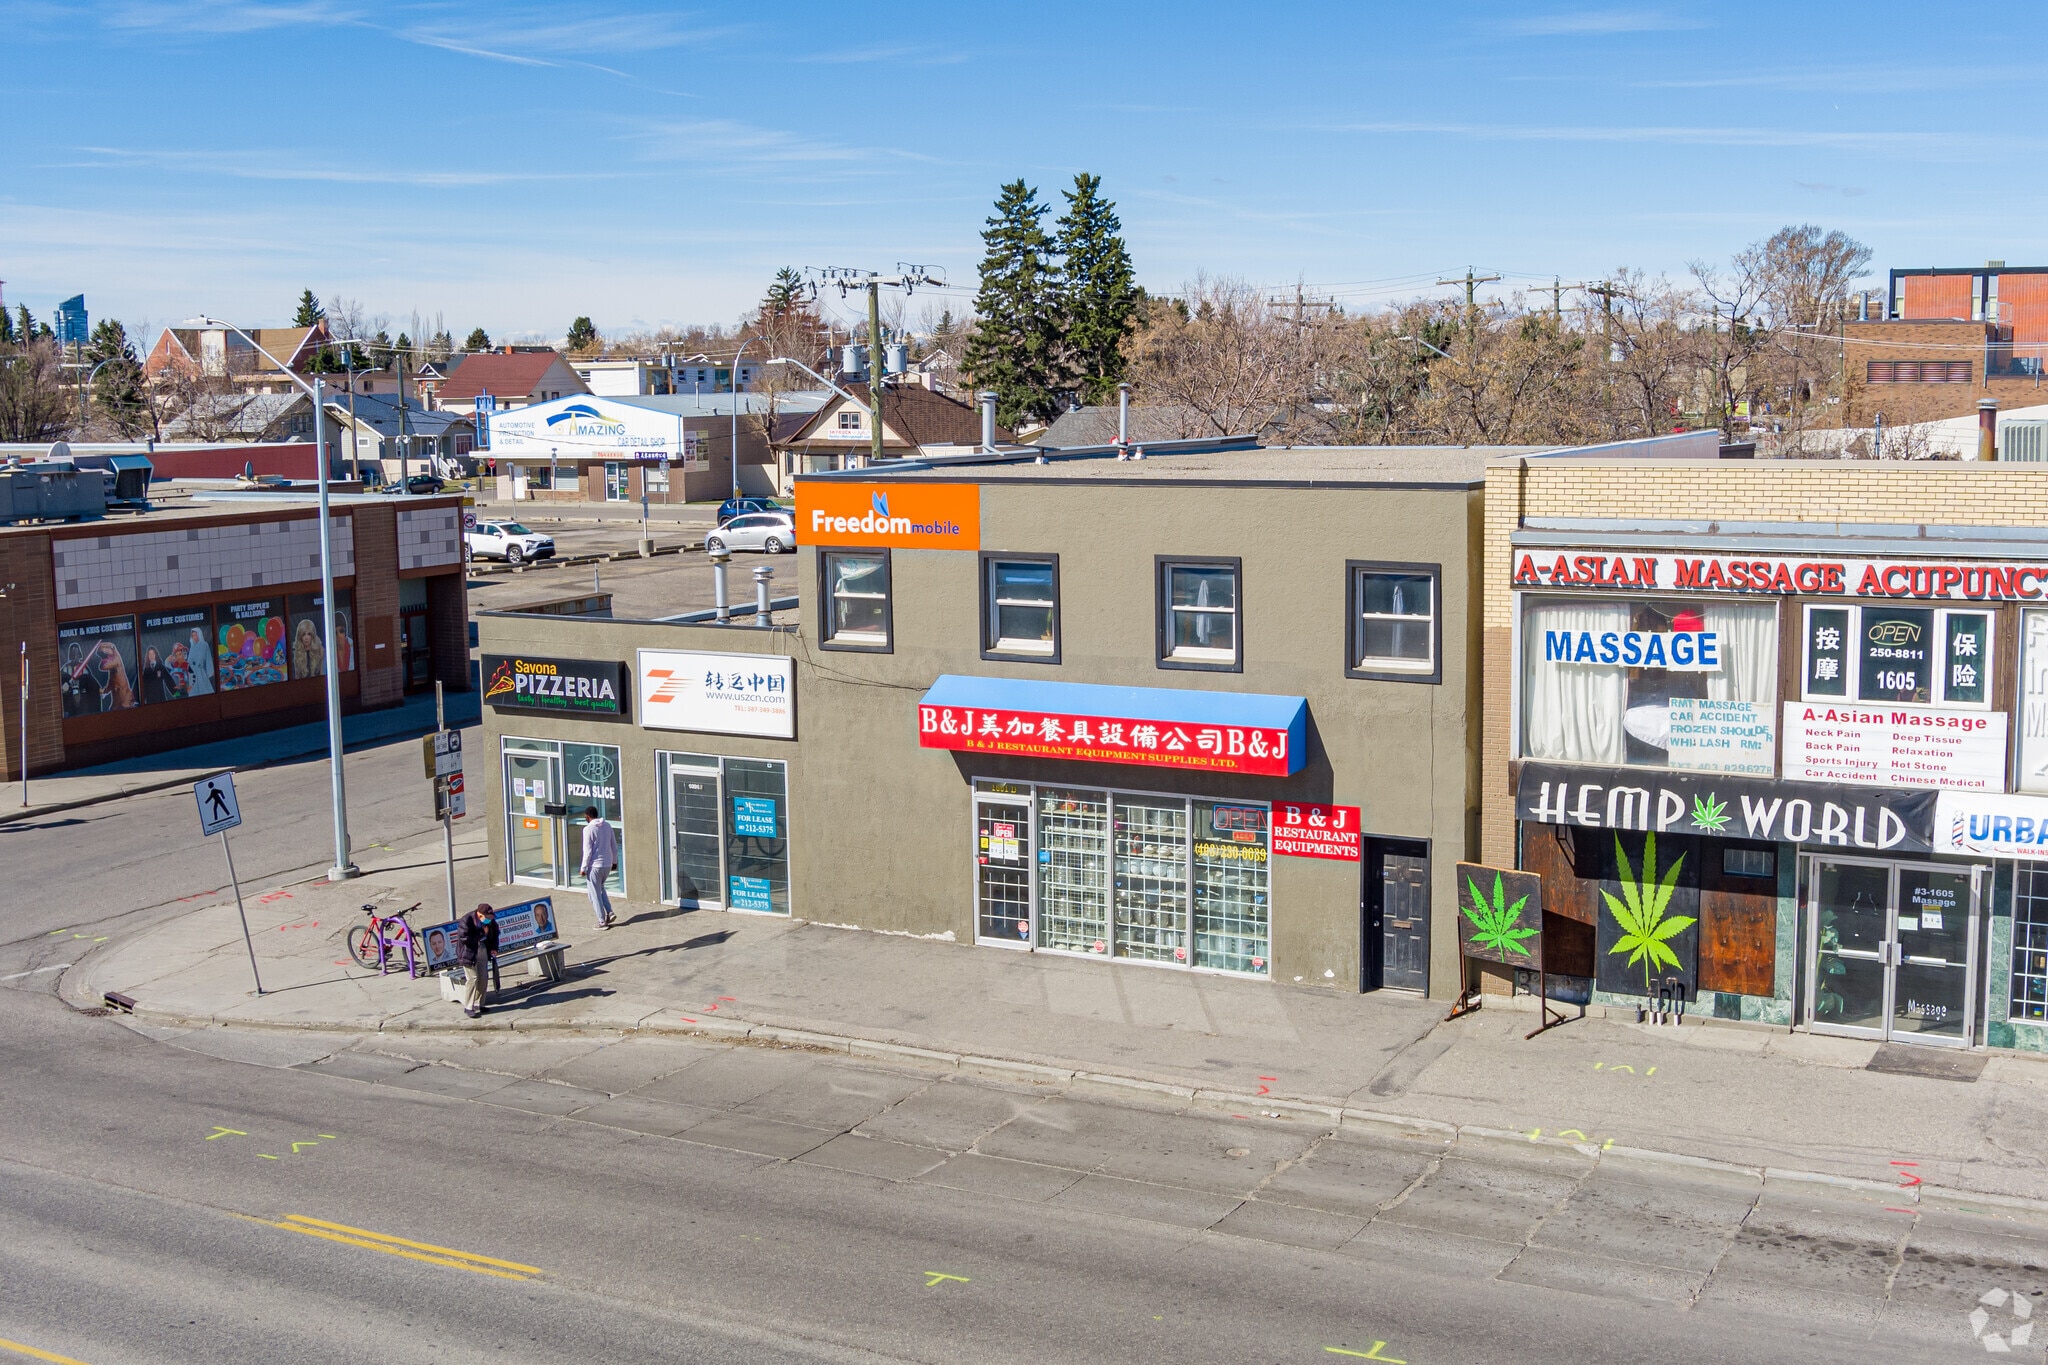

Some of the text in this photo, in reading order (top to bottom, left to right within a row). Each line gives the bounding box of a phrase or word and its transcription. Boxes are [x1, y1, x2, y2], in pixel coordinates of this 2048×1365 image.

[569, 413, 626, 435] AMAZING
[618, 437, 666, 447] CAR DETAIL SHOP
[812, 509, 960, 535] Freedom mobile
[1514, 554, 1658, 588] A-ASIAN
[1673, 558, 1846, 594] MASSAGE
[230, 602, 270, 613] PARTY SUPPLIES
[241, 609, 266, 618] BALLOONS
[146, 612, 204, 627] PLUS SIZE COSTUMES
[60, 629, 78, 638] ADULT
[86, 625, 100, 634] KIDS
[101, 621, 133, 632] COSTUMES
[1868, 624, 1922, 643] OPEN
[1545, 630, 1718, 666] MASSAGE
[1814, 626, 1841, 681] 按摩
[1869, 647, 1923, 660] 250-8811
[515, 659, 557, 675] Savona
[1952, 632, 1978, 687] 保险
[515, 674, 615, 699] PIZZERIA
[705, 670, 786, 694] 转运中国
[1877, 670, 1916, 691] 1605
[517, 694, 616, 711] tasty healthy best quality
[705, 691, 786, 704] www.uszcn.com
[1670, 698, 1752, 712] RMT MASSAGE
[734, 705, 747, 713] TEL:
[1670, 711, 1758, 723] CAR ACCIDENT
[1802, 708, 1987, 732] A-Asian Massage
[977, 713, 1223, 755] 美加餐具設備公司
[1670, 724, 1773, 742] FROZEN SHOULDER
[1805, 729, 1861, 739] Neck Pain
[1893, 733, 1962, 745] Deep Tissue
[976, 740, 985, 748] &
[997, 742, 1073, 755] RESTAURANT
[1076, 748, 1148, 761] EQUIPMENT
[1148, 753, 1207, 765] SUPPLIES
[1210, 757, 1238, 768] LTD.
[1805, 742, 1860, 752] Back Pain
[1892, 747, 1953, 758] Relaxation
[580, 761, 611, 776] OPEN
[1805, 755, 1878, 769] Sports Injury
[1891, 760, 1947, 772] Hot Stone
[1805, 769, 1877, 781] Car Accident
[1891, 774, 1985, 788] Chinese Medical
[567, 783, 616, 799] PIZZA SLICE
[737, 814, 773, 824] FOR LEASE
[1215, 807, 1267, 831] OPEN
[1285, 806, 1347, 829] B & J
[1529, 781, 1906, 850] HEMP WORLD
[745, 824, 774, 834] 212-5375
[1274, 826, 1358, 843] RESTAURANT
[1274, 839, 1359, 857] EQUIPMENTS
[732, 889, 769, 899] FOR LEASE
[1914, 887, 1954, 898] #3-1605
[740, 899, 769, 909] 212-5375
[1912, 896, 1956, 907] Massage
[505, 913, 530, 925] WILLIAMS
